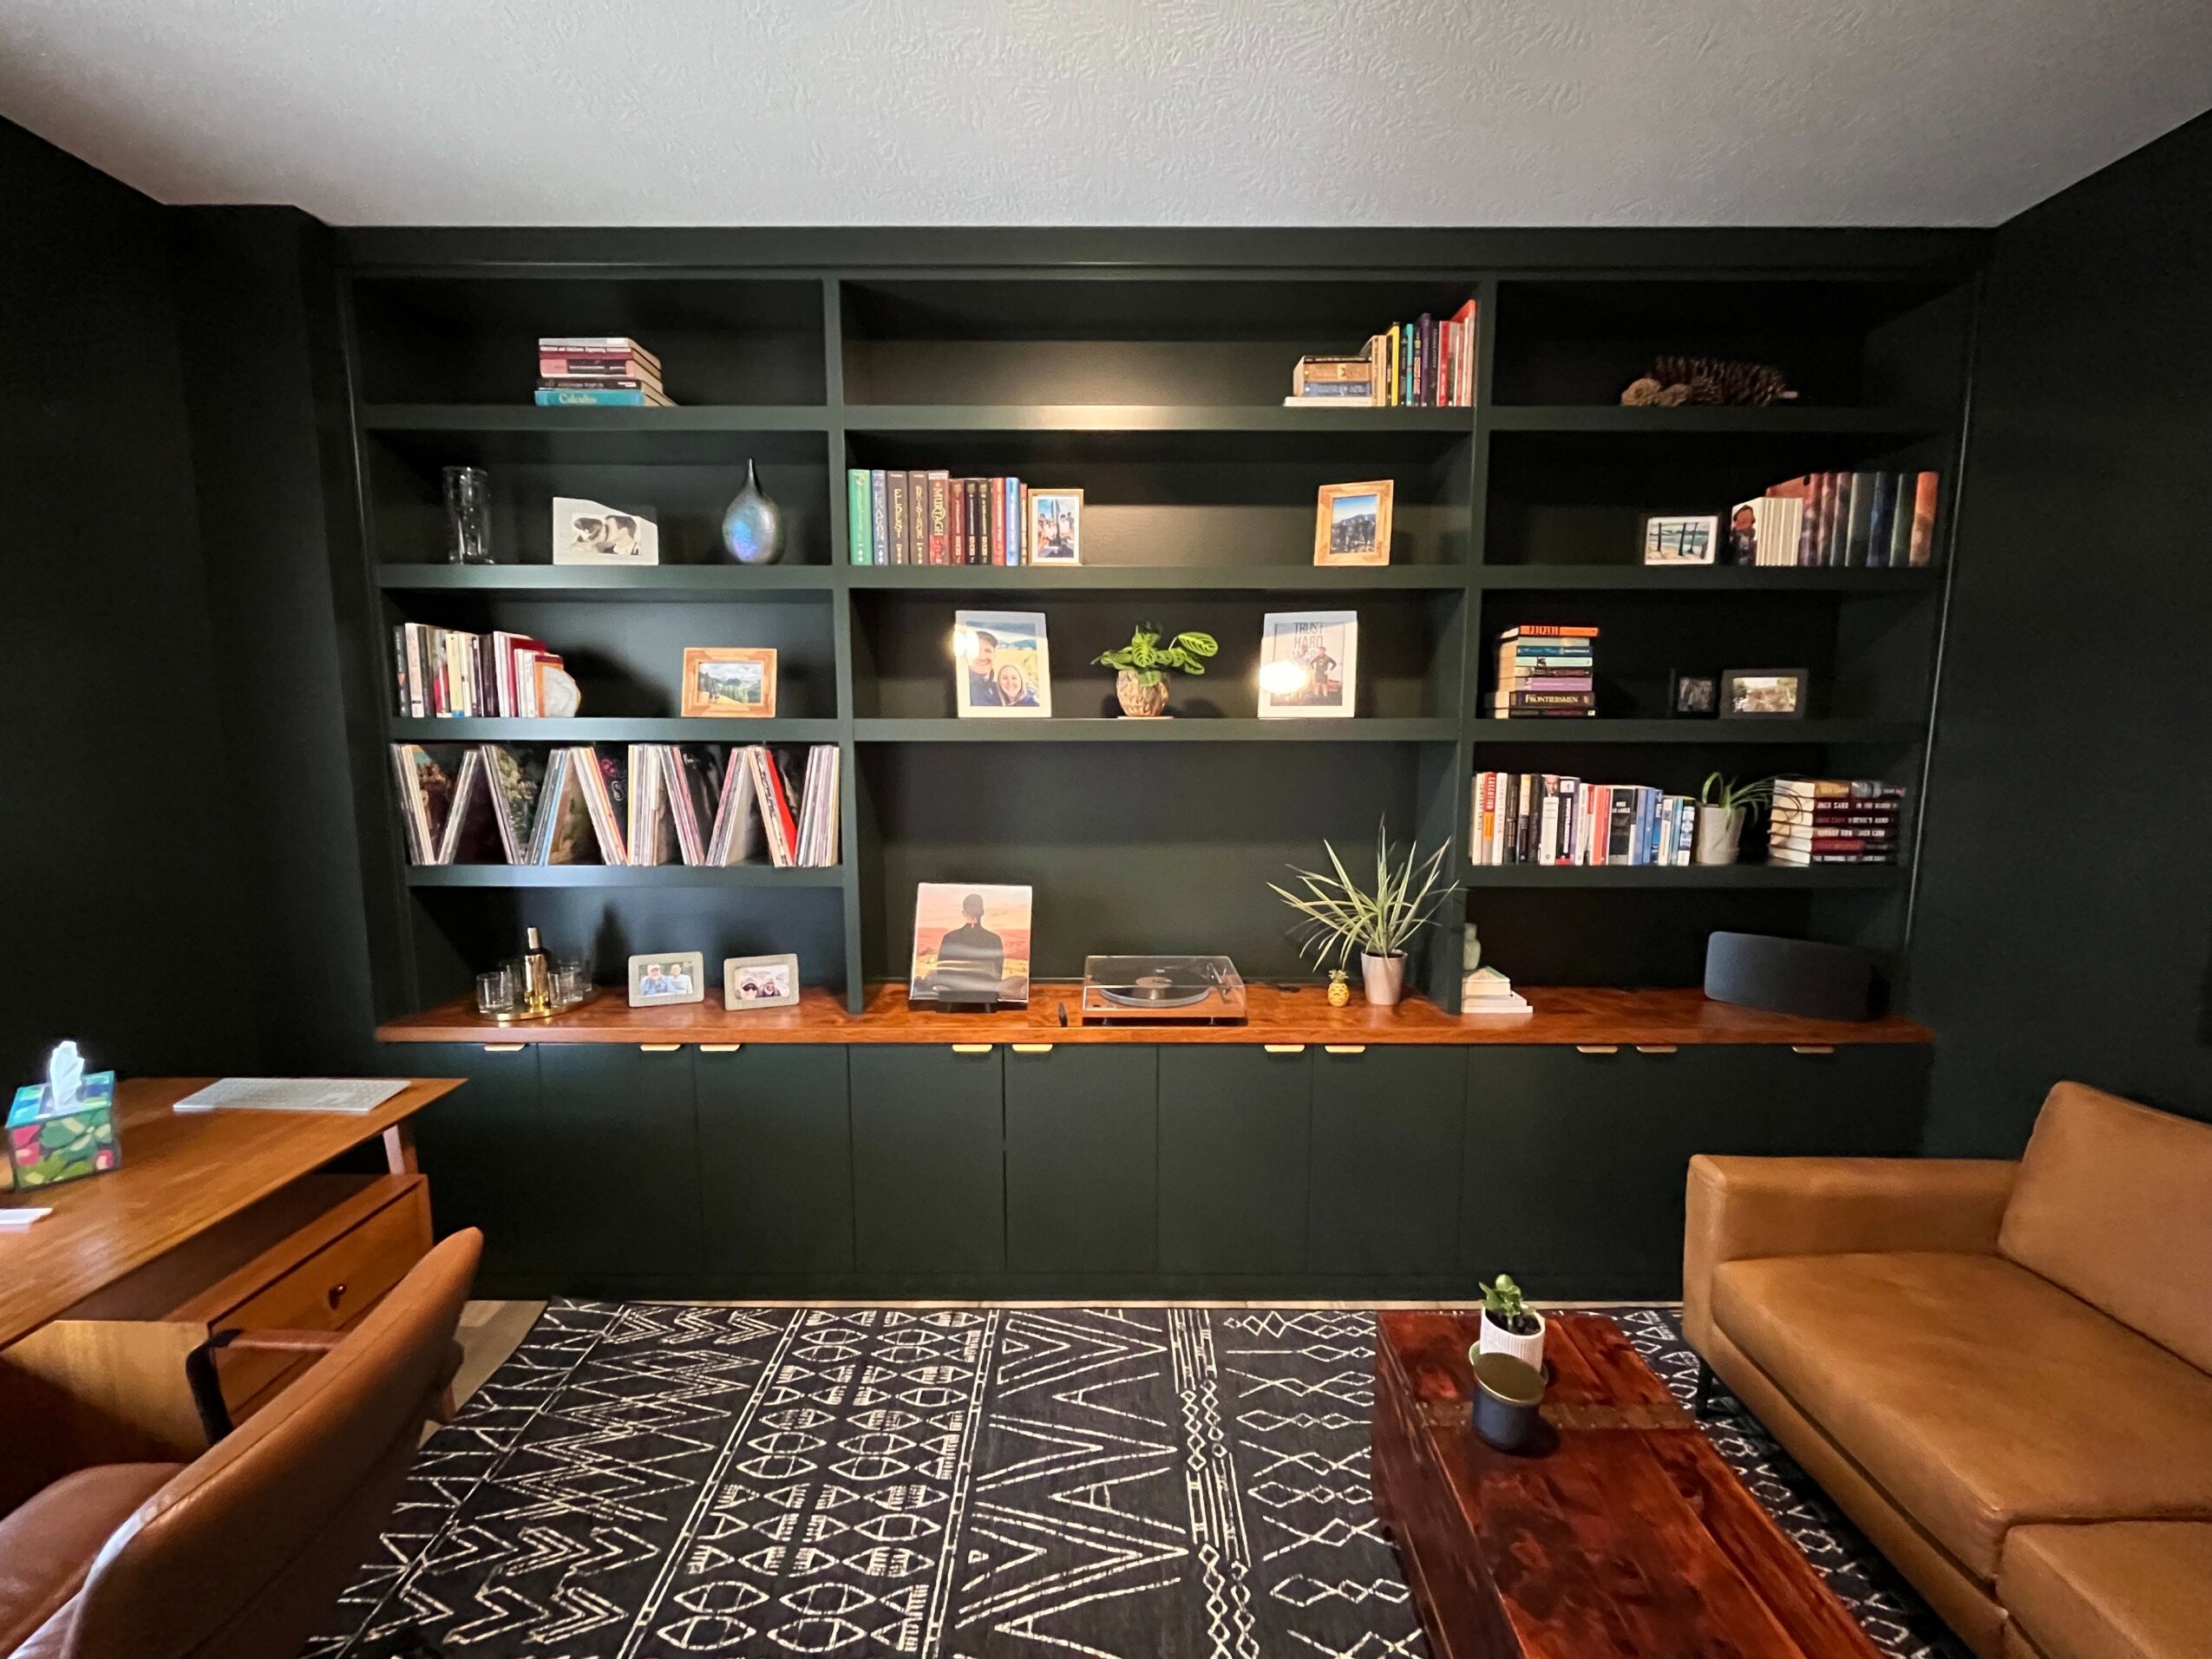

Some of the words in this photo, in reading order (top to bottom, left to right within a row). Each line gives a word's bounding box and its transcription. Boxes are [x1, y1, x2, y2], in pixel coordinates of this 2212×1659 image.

[559, 394, 597, 404] Calculus
[893, 488, 903, 539] ELDEST
[931, 487, 946, 536] MURTAGH
[1294, 622, 1324, 635] TRUST
[1294, 635, 1324, 650] HARD
[1525, 694, 1579, 703] FRONTIERSMEN
[1486, 776, 1495, 810] EXECUTION
